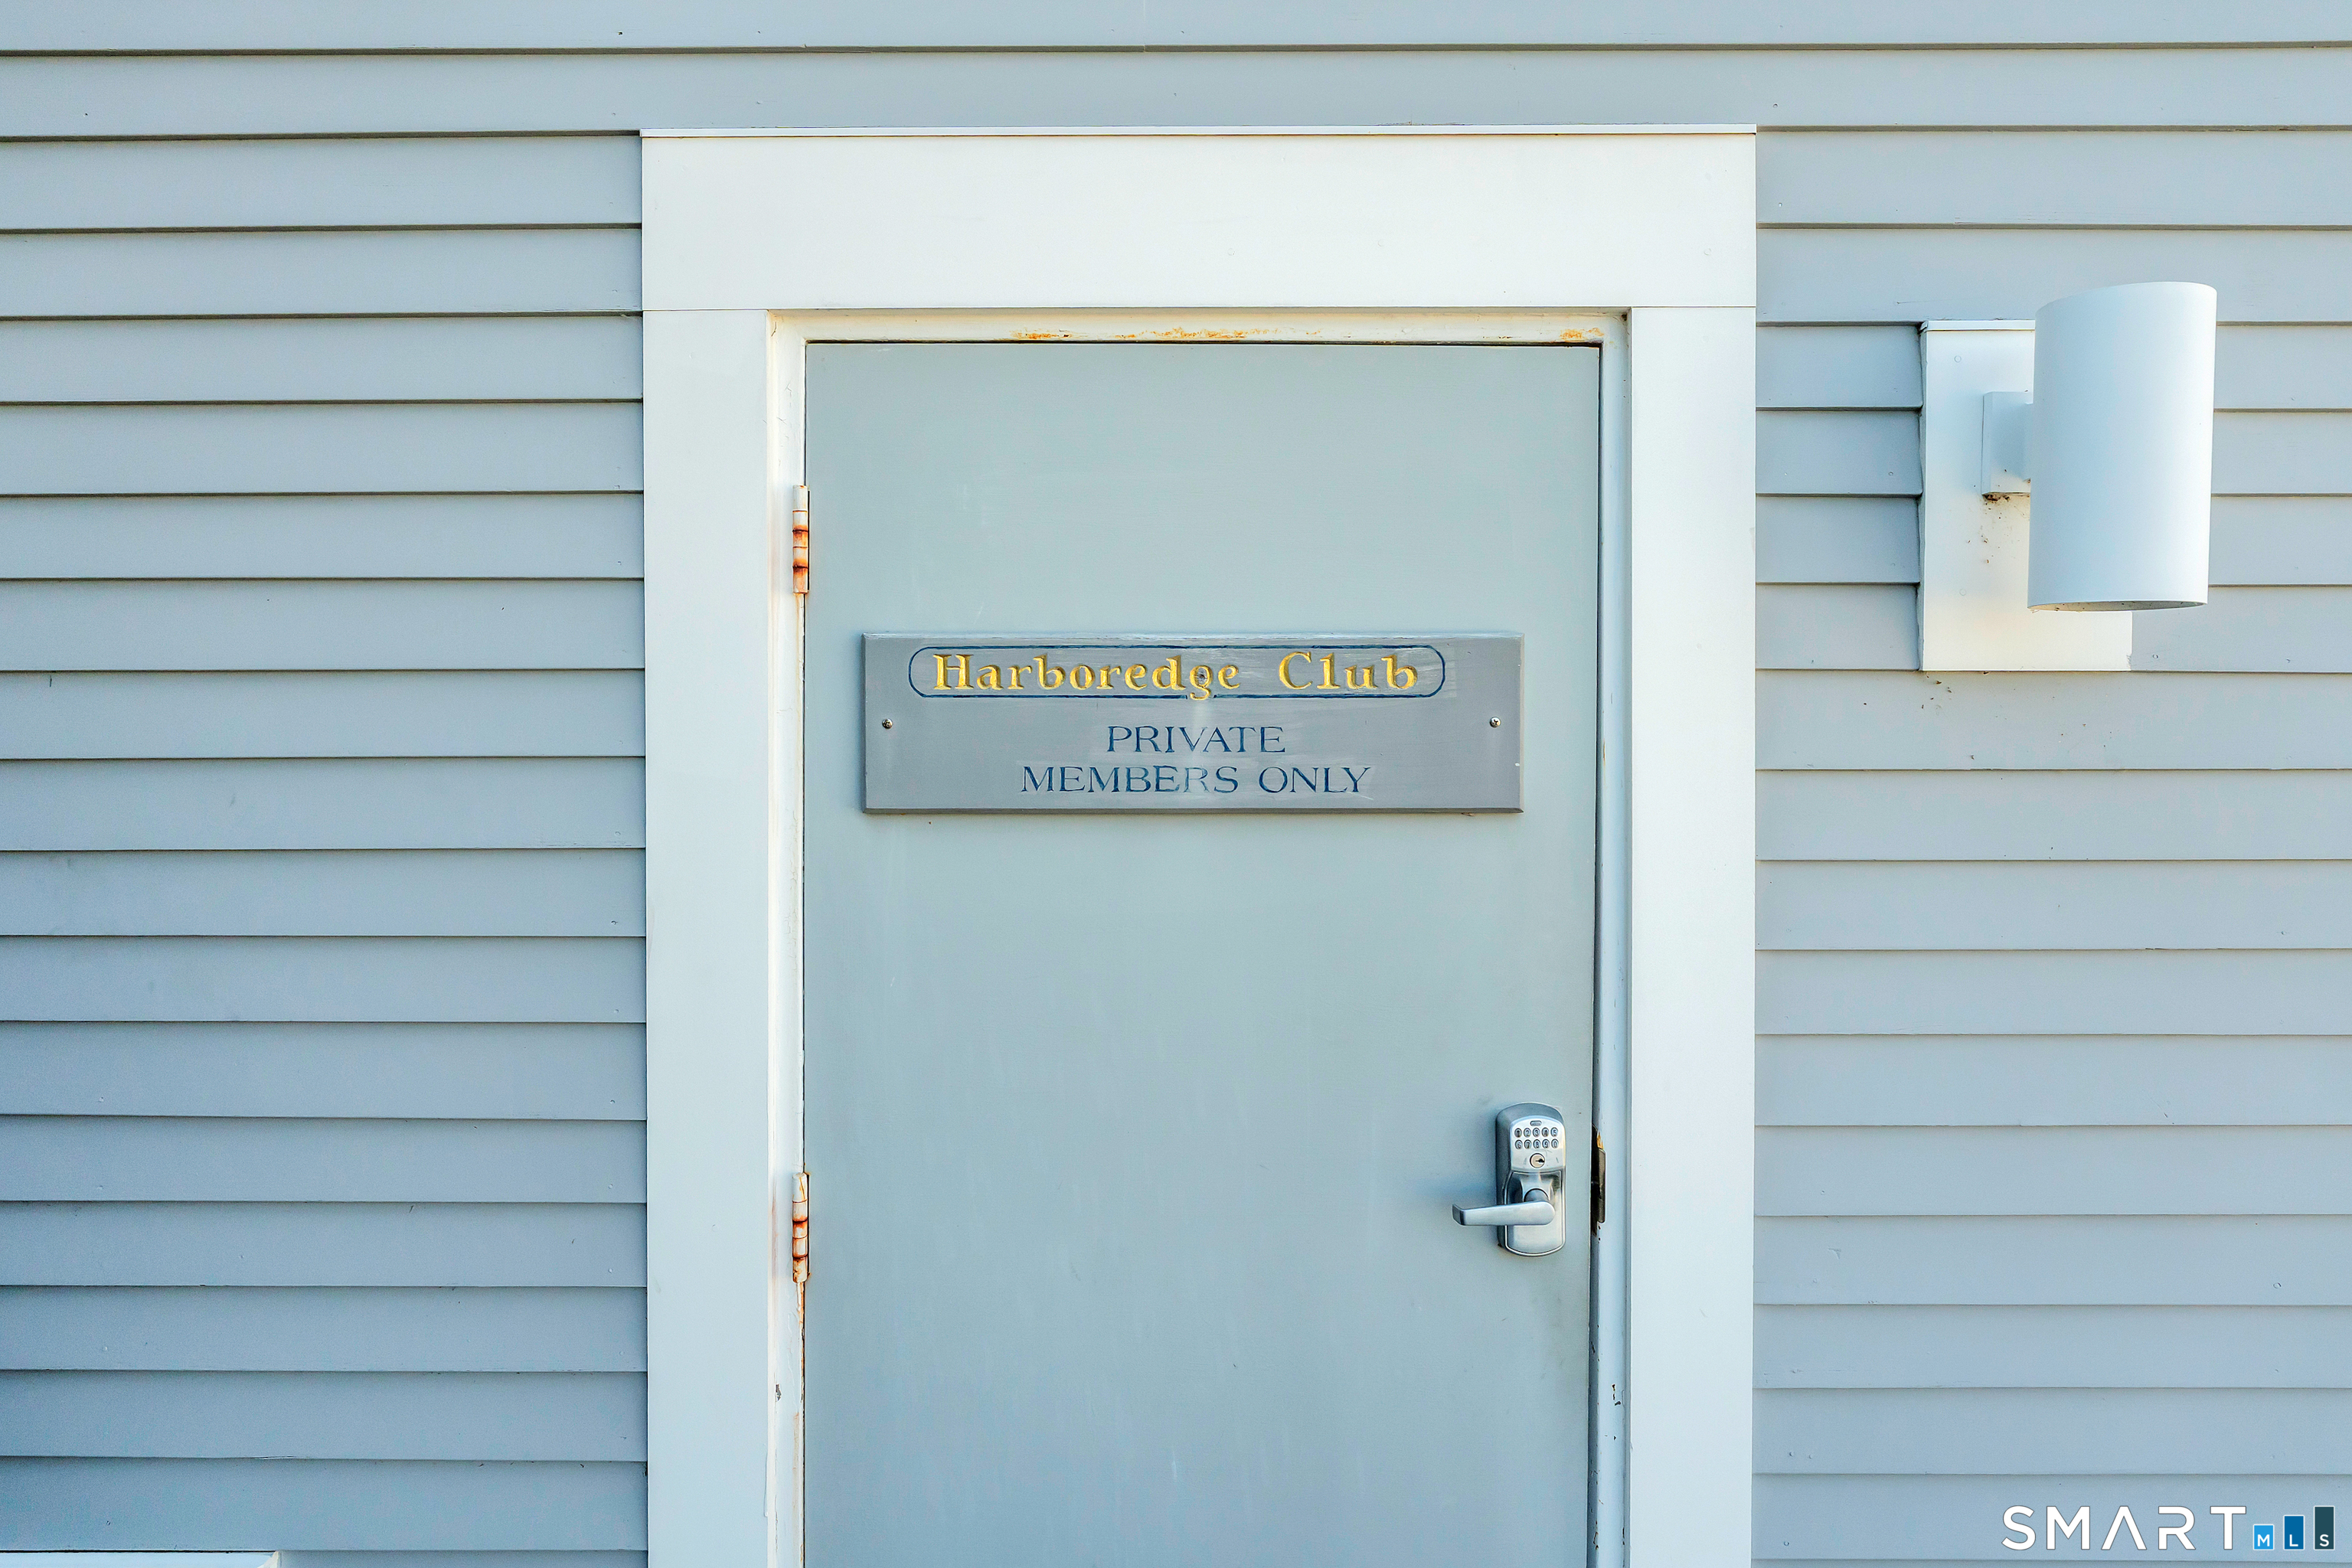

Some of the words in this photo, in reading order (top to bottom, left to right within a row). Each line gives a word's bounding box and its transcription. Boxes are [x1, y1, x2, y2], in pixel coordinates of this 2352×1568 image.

[933, 653, 1240, 701] Harboredge
[1279, 652, 1419, 691] Club
[1107, 725, 1286, 753] PRIVATE
[1021, 766, 1239, 794] MEMBERS
[1258, 766, 1372, 794] ONLY
